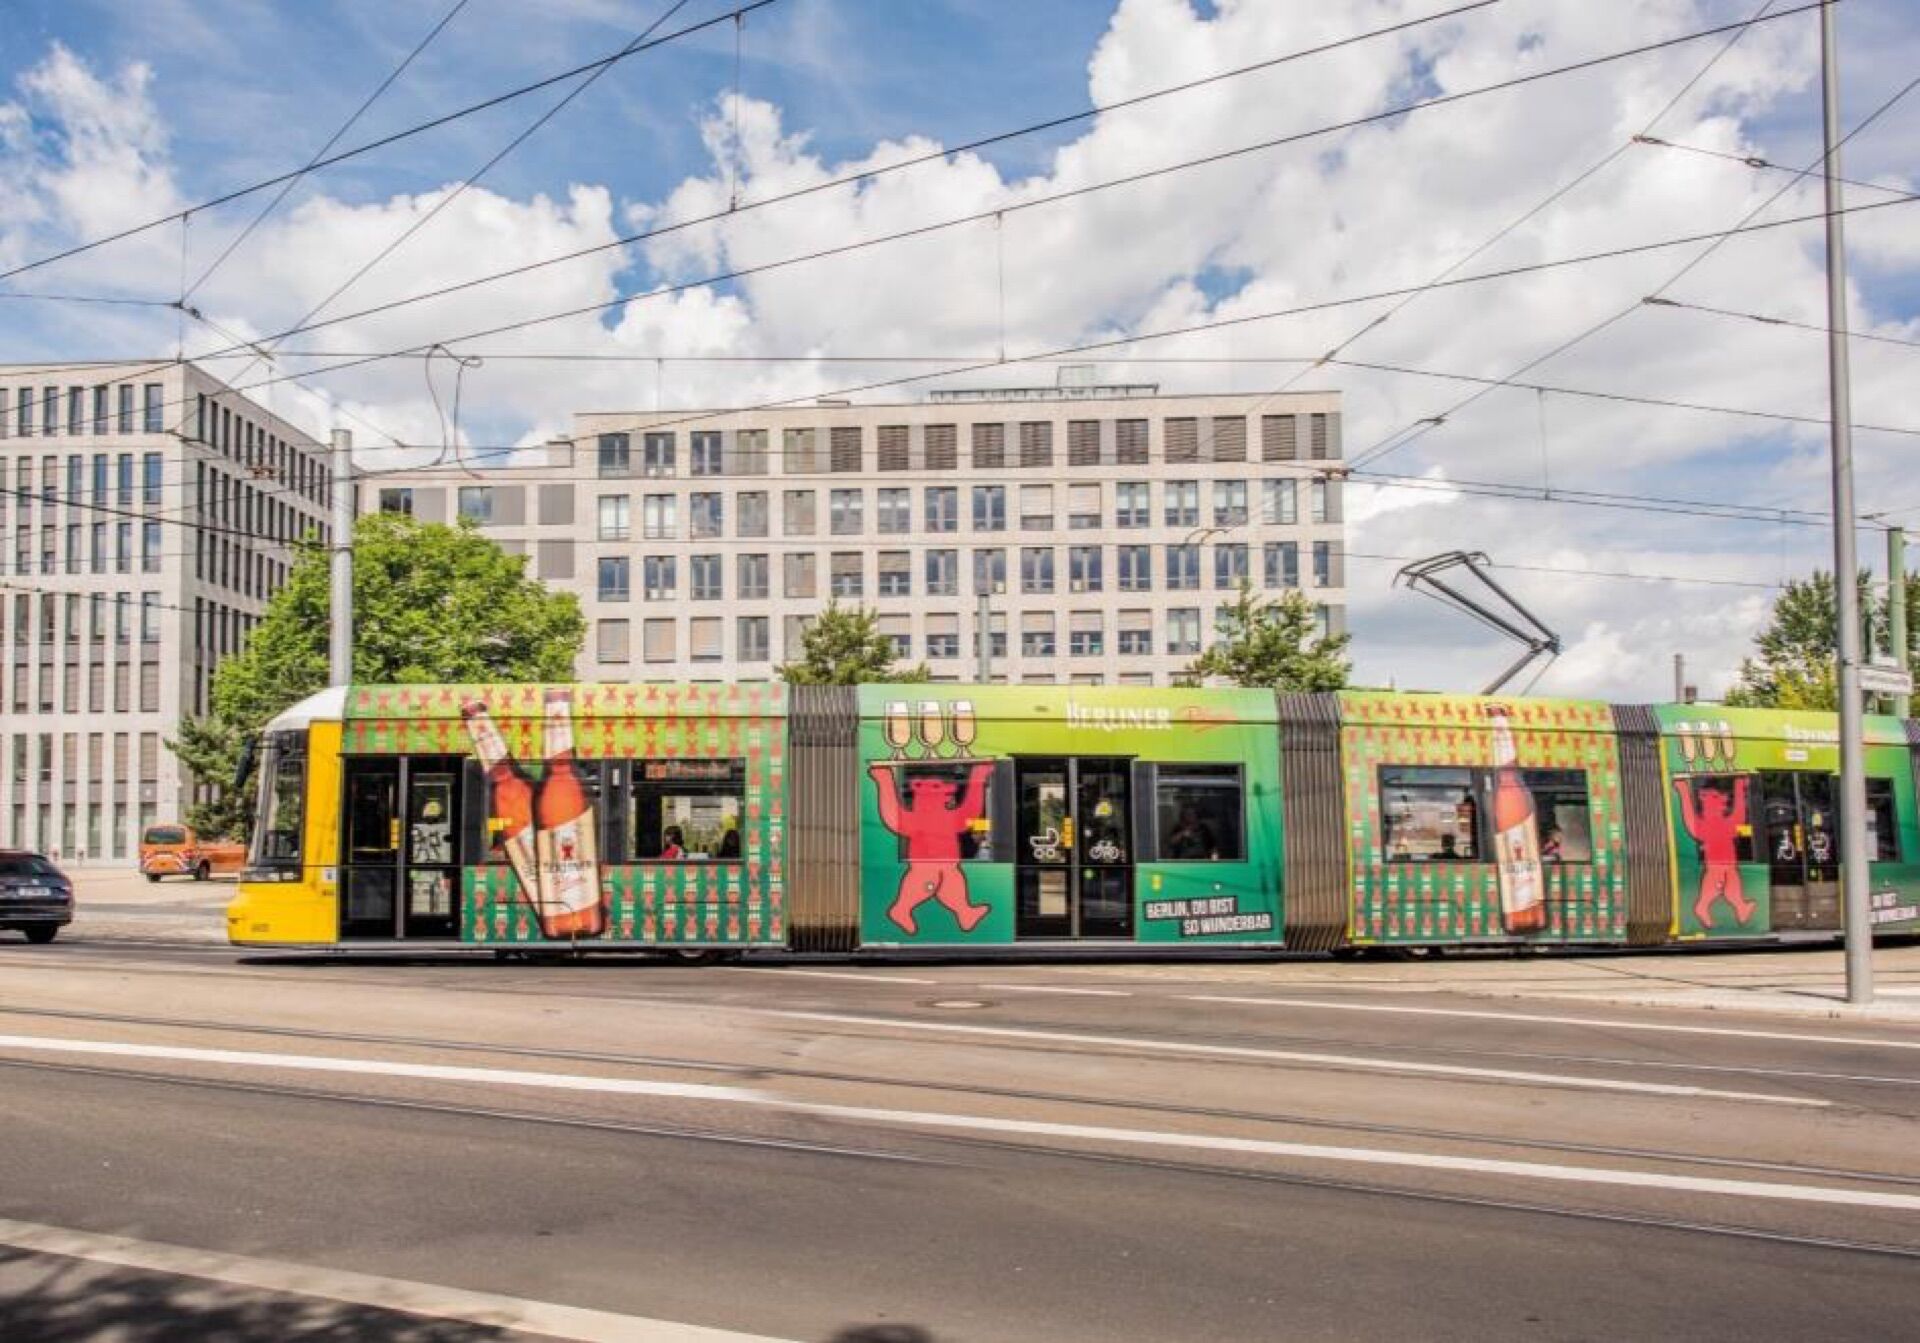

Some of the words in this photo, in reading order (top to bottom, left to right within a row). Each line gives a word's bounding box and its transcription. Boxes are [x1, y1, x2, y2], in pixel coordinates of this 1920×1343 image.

[1066, 701, 1172, 731] BERLINER
[1191, 899, 1208, 915] DU
[1209, 897, 1235, 914] BIST
[1184, 919, 1199, 934] SO
[1200, 914, 1270, 932] WUNDERBAR
